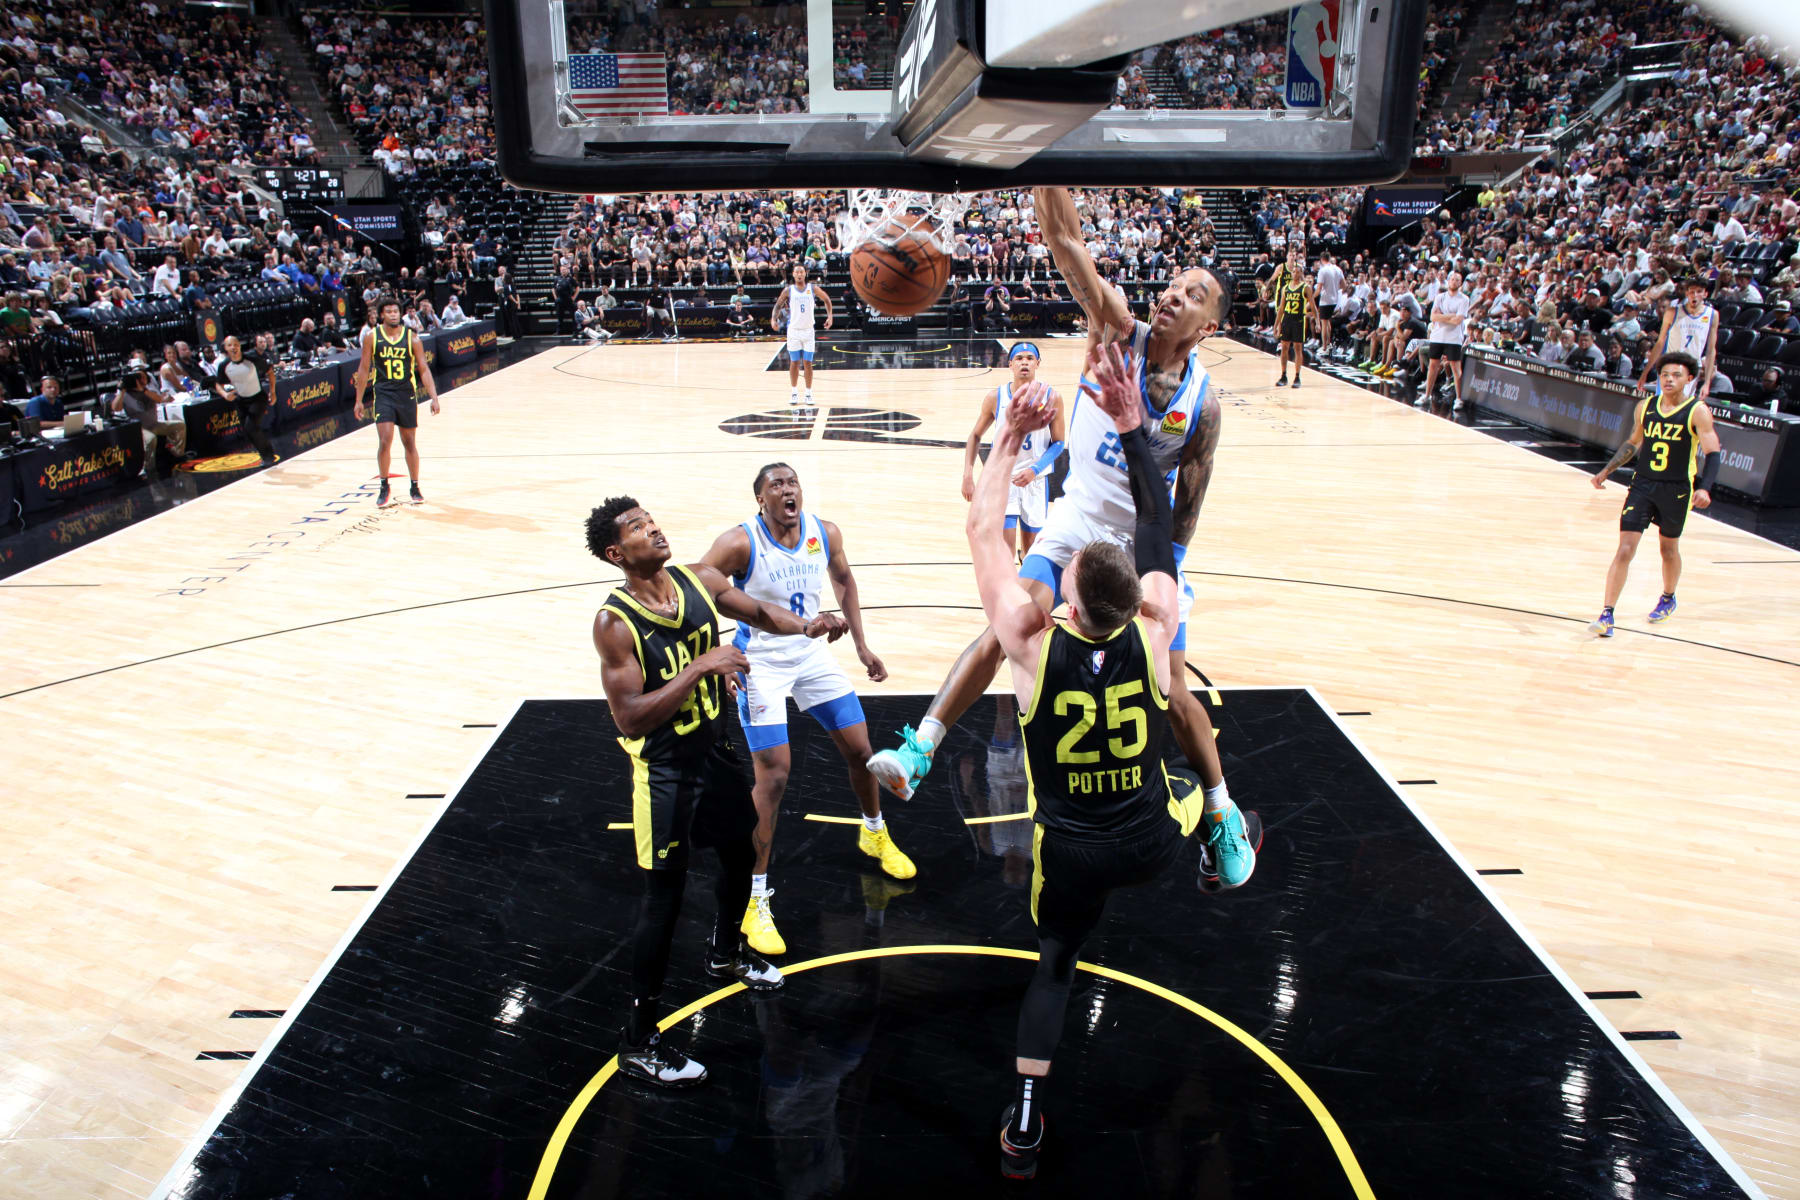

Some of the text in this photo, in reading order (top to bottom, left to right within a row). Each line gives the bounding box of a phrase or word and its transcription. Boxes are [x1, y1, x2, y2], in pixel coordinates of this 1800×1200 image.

[1291, 82, 1315, 102] NBA
[268, 178, 280, 188] 40
[294, 170, 316, 182] 4:27
[327, 178, 338, 188] 28
[1286, 293, 1300, 301] JAZZ
[1285, 301, 1299, 314] 42
[1685, 335, 1693, 348] 7
[380, 346, 406, 359] JAZZ
[384, 359, 405, 380] 13
[1470, 374, 1489, 393] August
[1502, 383, 1519, 401] 2023
[1581, 405, 1598, 425] PGA
[1598, 410, 1623, 432] TOUR
[1748, 415, 1774, 429] DELTA
[1644, 421, 1683, 441] JAZZ
[45, 444, 125, 489] Salt Lake City
[1650, 441, 1670, 472] 3
[155, 530, 306, 598] CENTER
[769, 563, 820, 583] OKLAHOMA
[786, 578, 807, 592] CITY
[790, 592, 805, 619] 8
[1053, 679, 1148, 763] 25
[1068, 765, 1143, 794] POTTER
